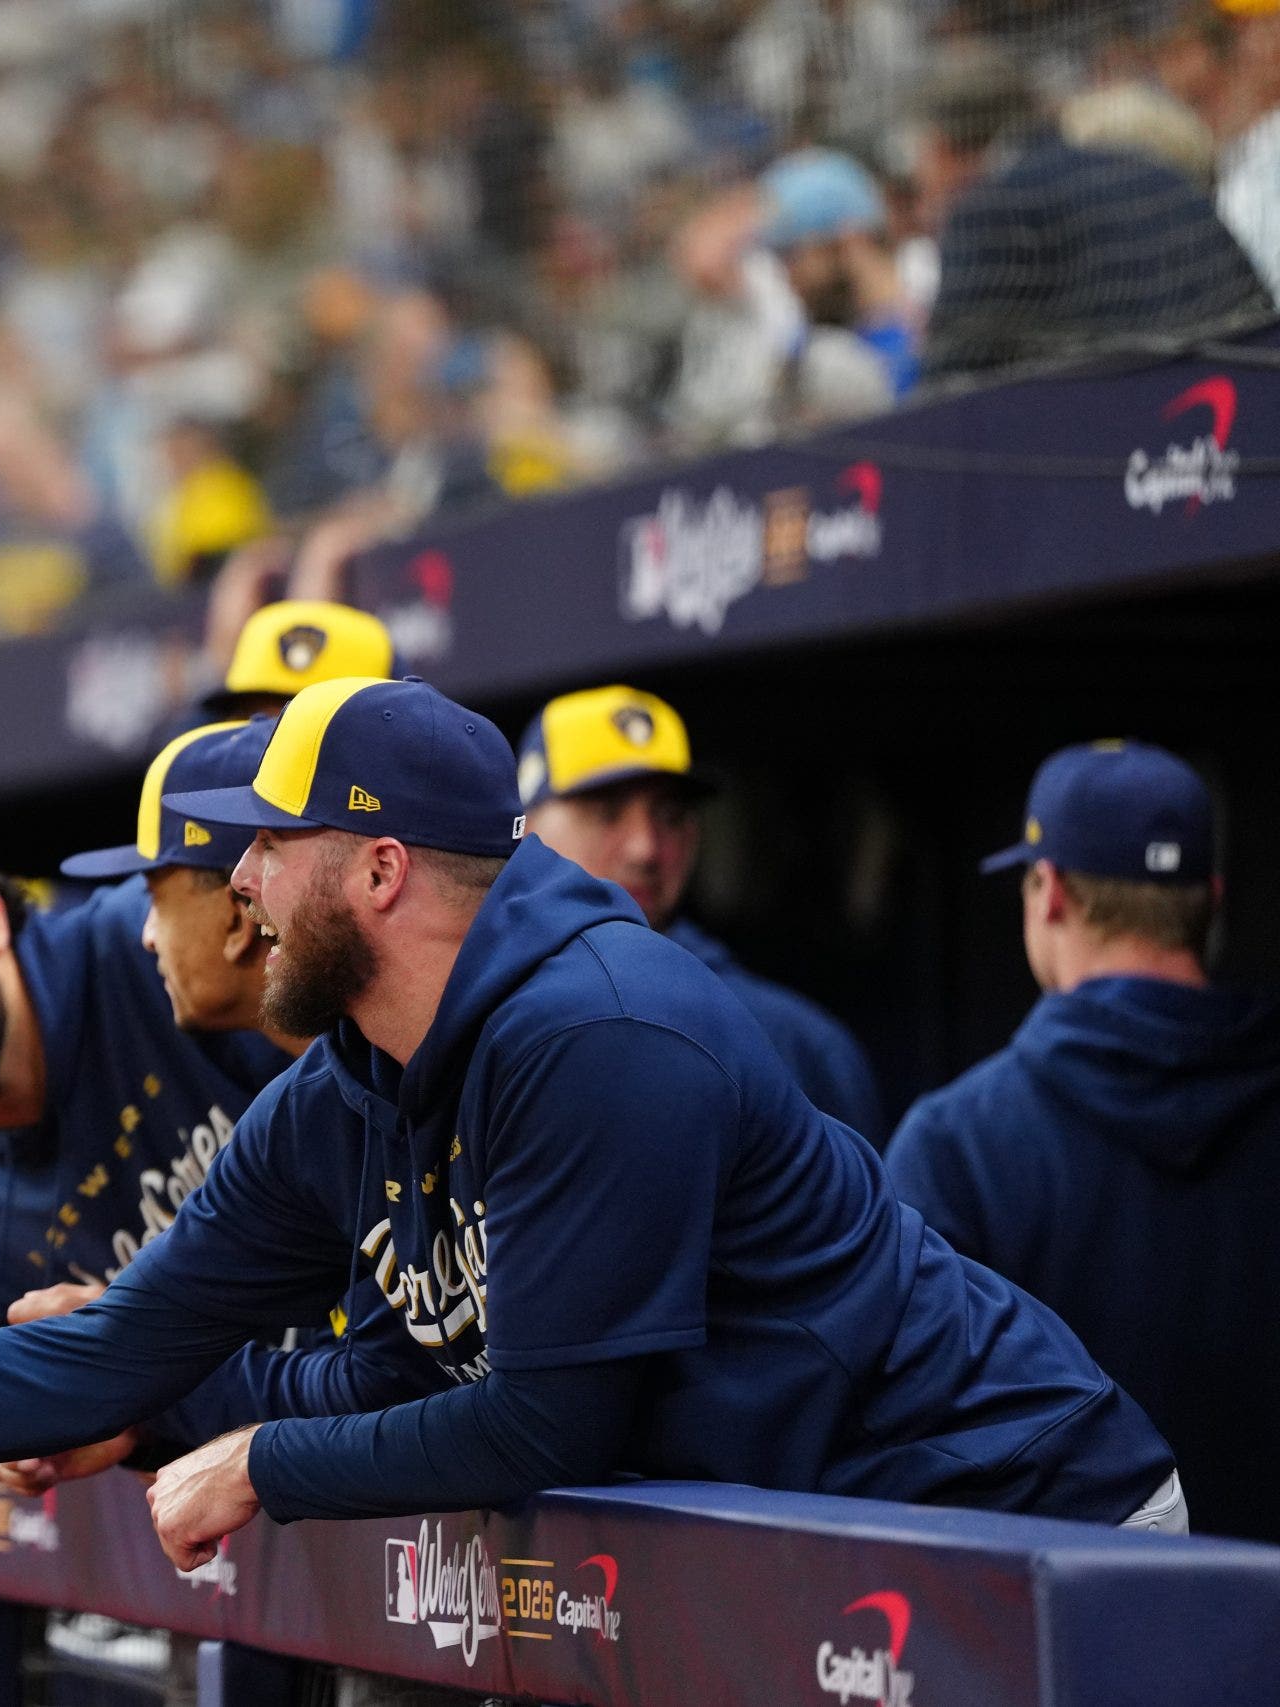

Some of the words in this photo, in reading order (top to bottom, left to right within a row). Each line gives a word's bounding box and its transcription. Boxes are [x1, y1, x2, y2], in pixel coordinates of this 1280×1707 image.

[418, 1518, 472, 1622] World
[501, 1577, 555, 1621] 2026
[556, 1590, 601, 1635] Capital
